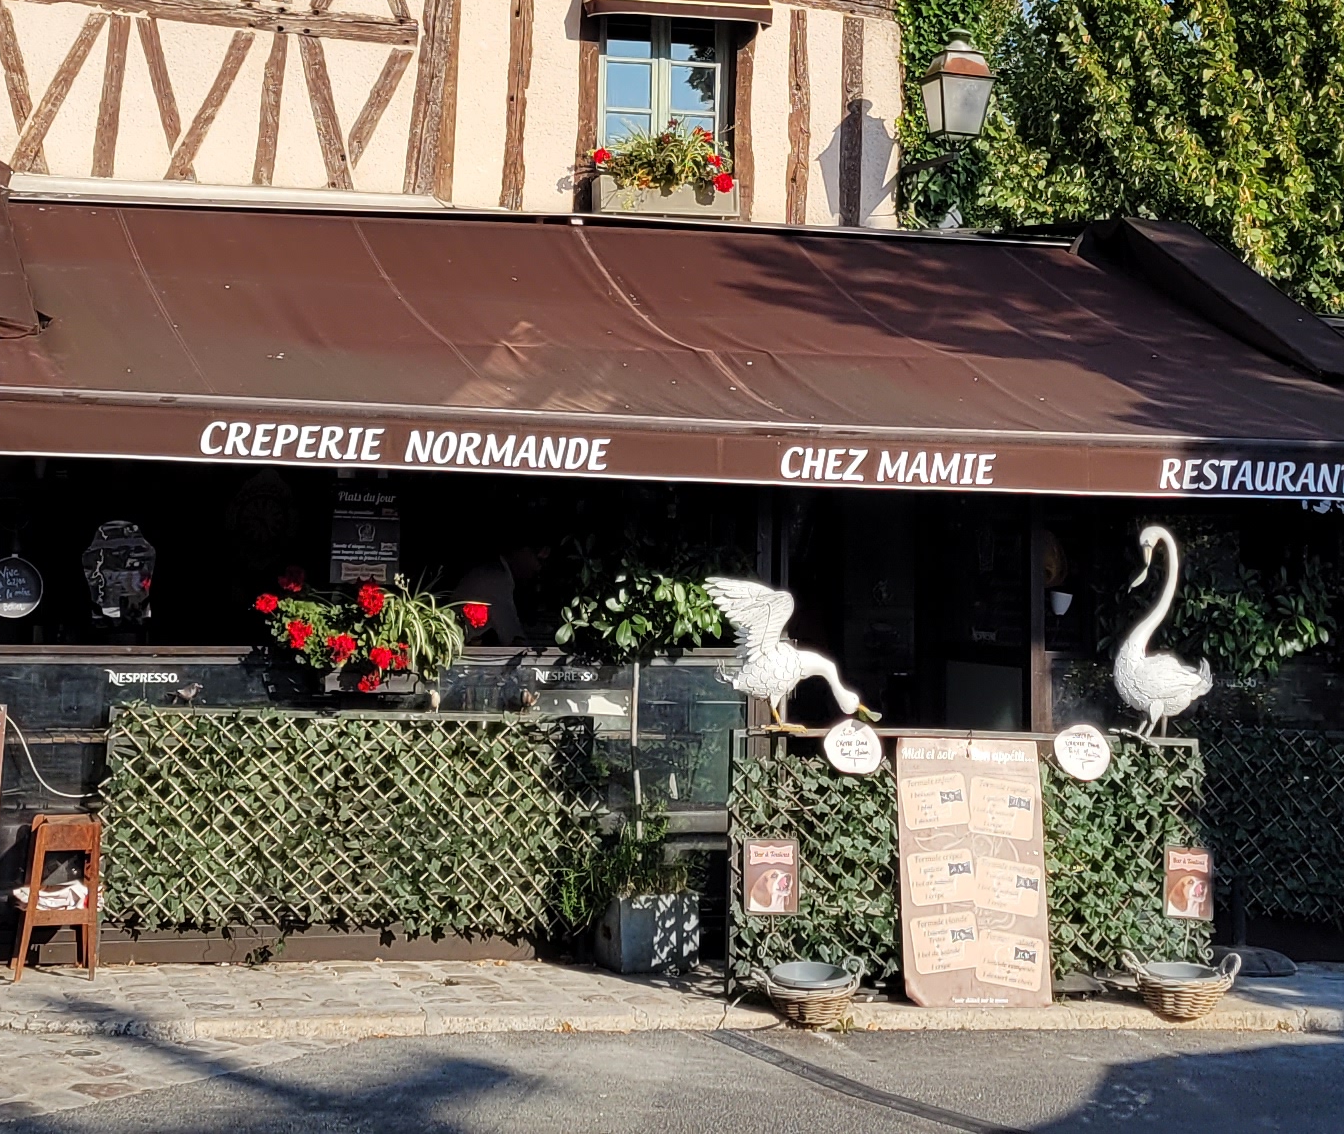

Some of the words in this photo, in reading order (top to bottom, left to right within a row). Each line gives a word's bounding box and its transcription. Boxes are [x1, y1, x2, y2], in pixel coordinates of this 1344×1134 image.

[199, 420, 385, 461] CREPERIE
[404, 430, 611, 471] NORMANDE
[780, 446, 869, 484] CHEZ
[876, 450, 996, 486] MAMIE
[901, 747, 925, 760] Midi
[936, 748, 957, 761] soir
